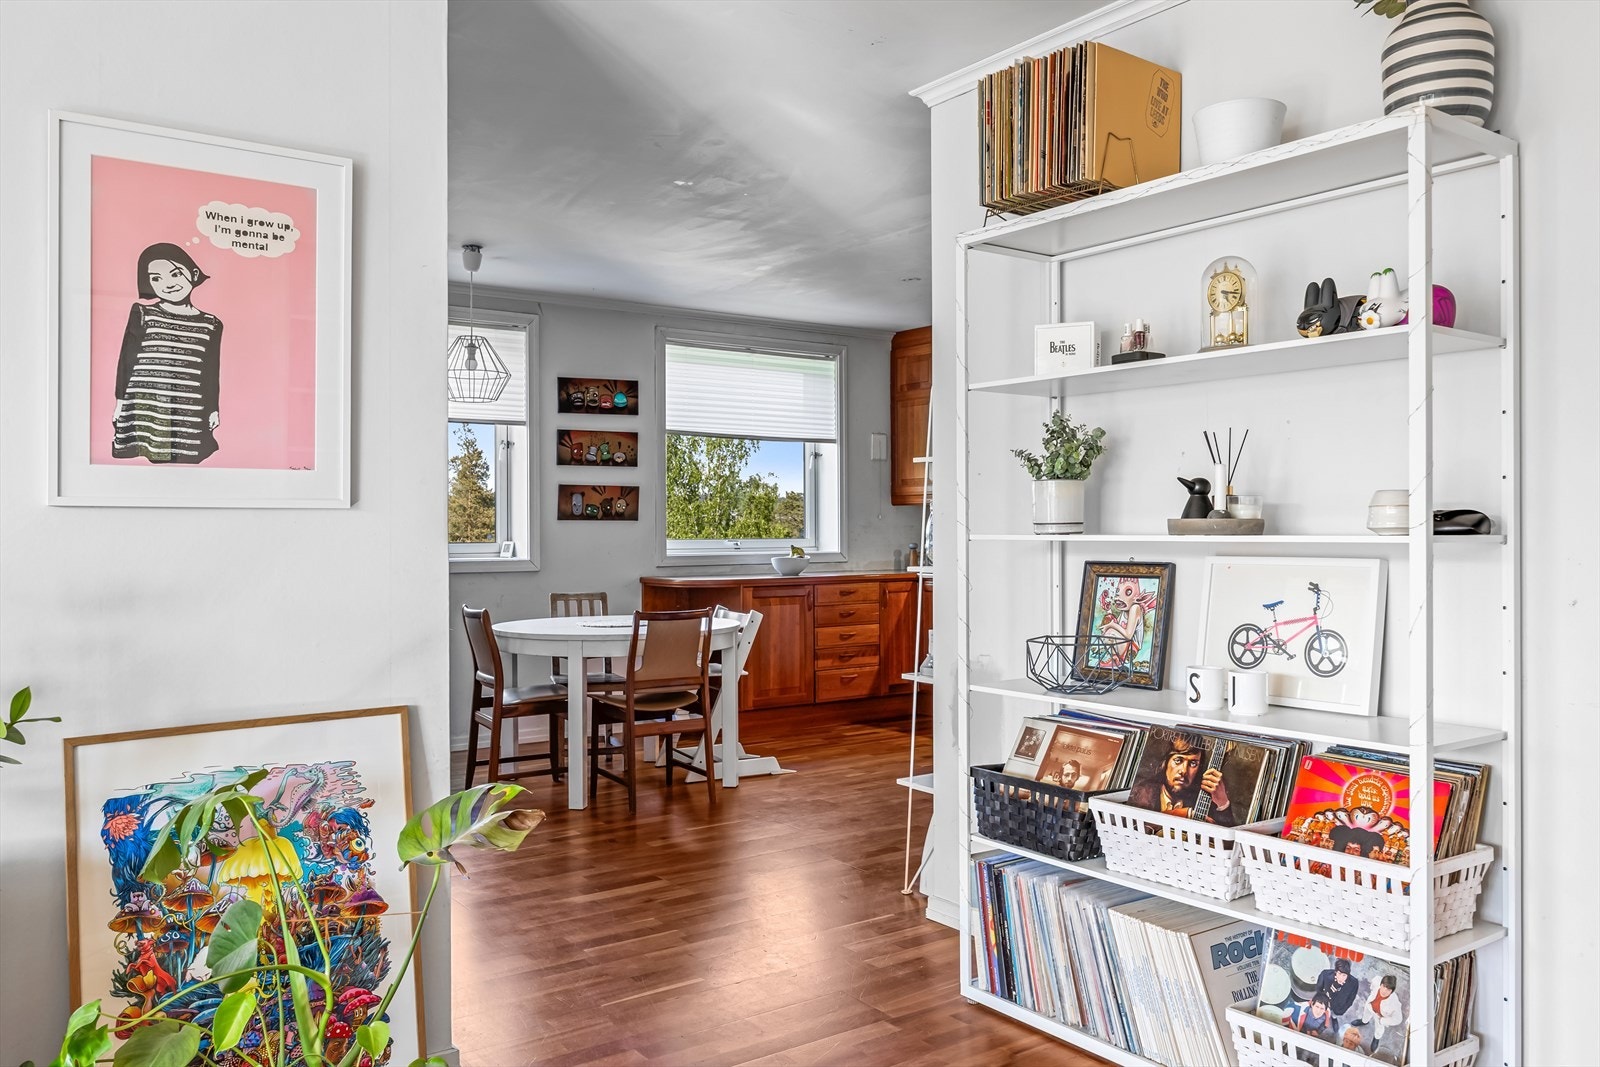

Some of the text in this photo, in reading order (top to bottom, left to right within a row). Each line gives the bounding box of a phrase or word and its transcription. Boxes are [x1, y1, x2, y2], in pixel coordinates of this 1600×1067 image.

[205, 210, 237, 223] When
[246, 218, 275, 228] grow
[277, 222, 294, 232] up,
[214, 224, 285, 241] I'm gonna be
[231, 239, 268, 251] mental
[1049, 341, 1076, 355] BEATLES
[1189, 672, 1201, 703] S
[1245, 970, 1260, 985] THE
[1231, 984, 1259, 1004] ROLLING
